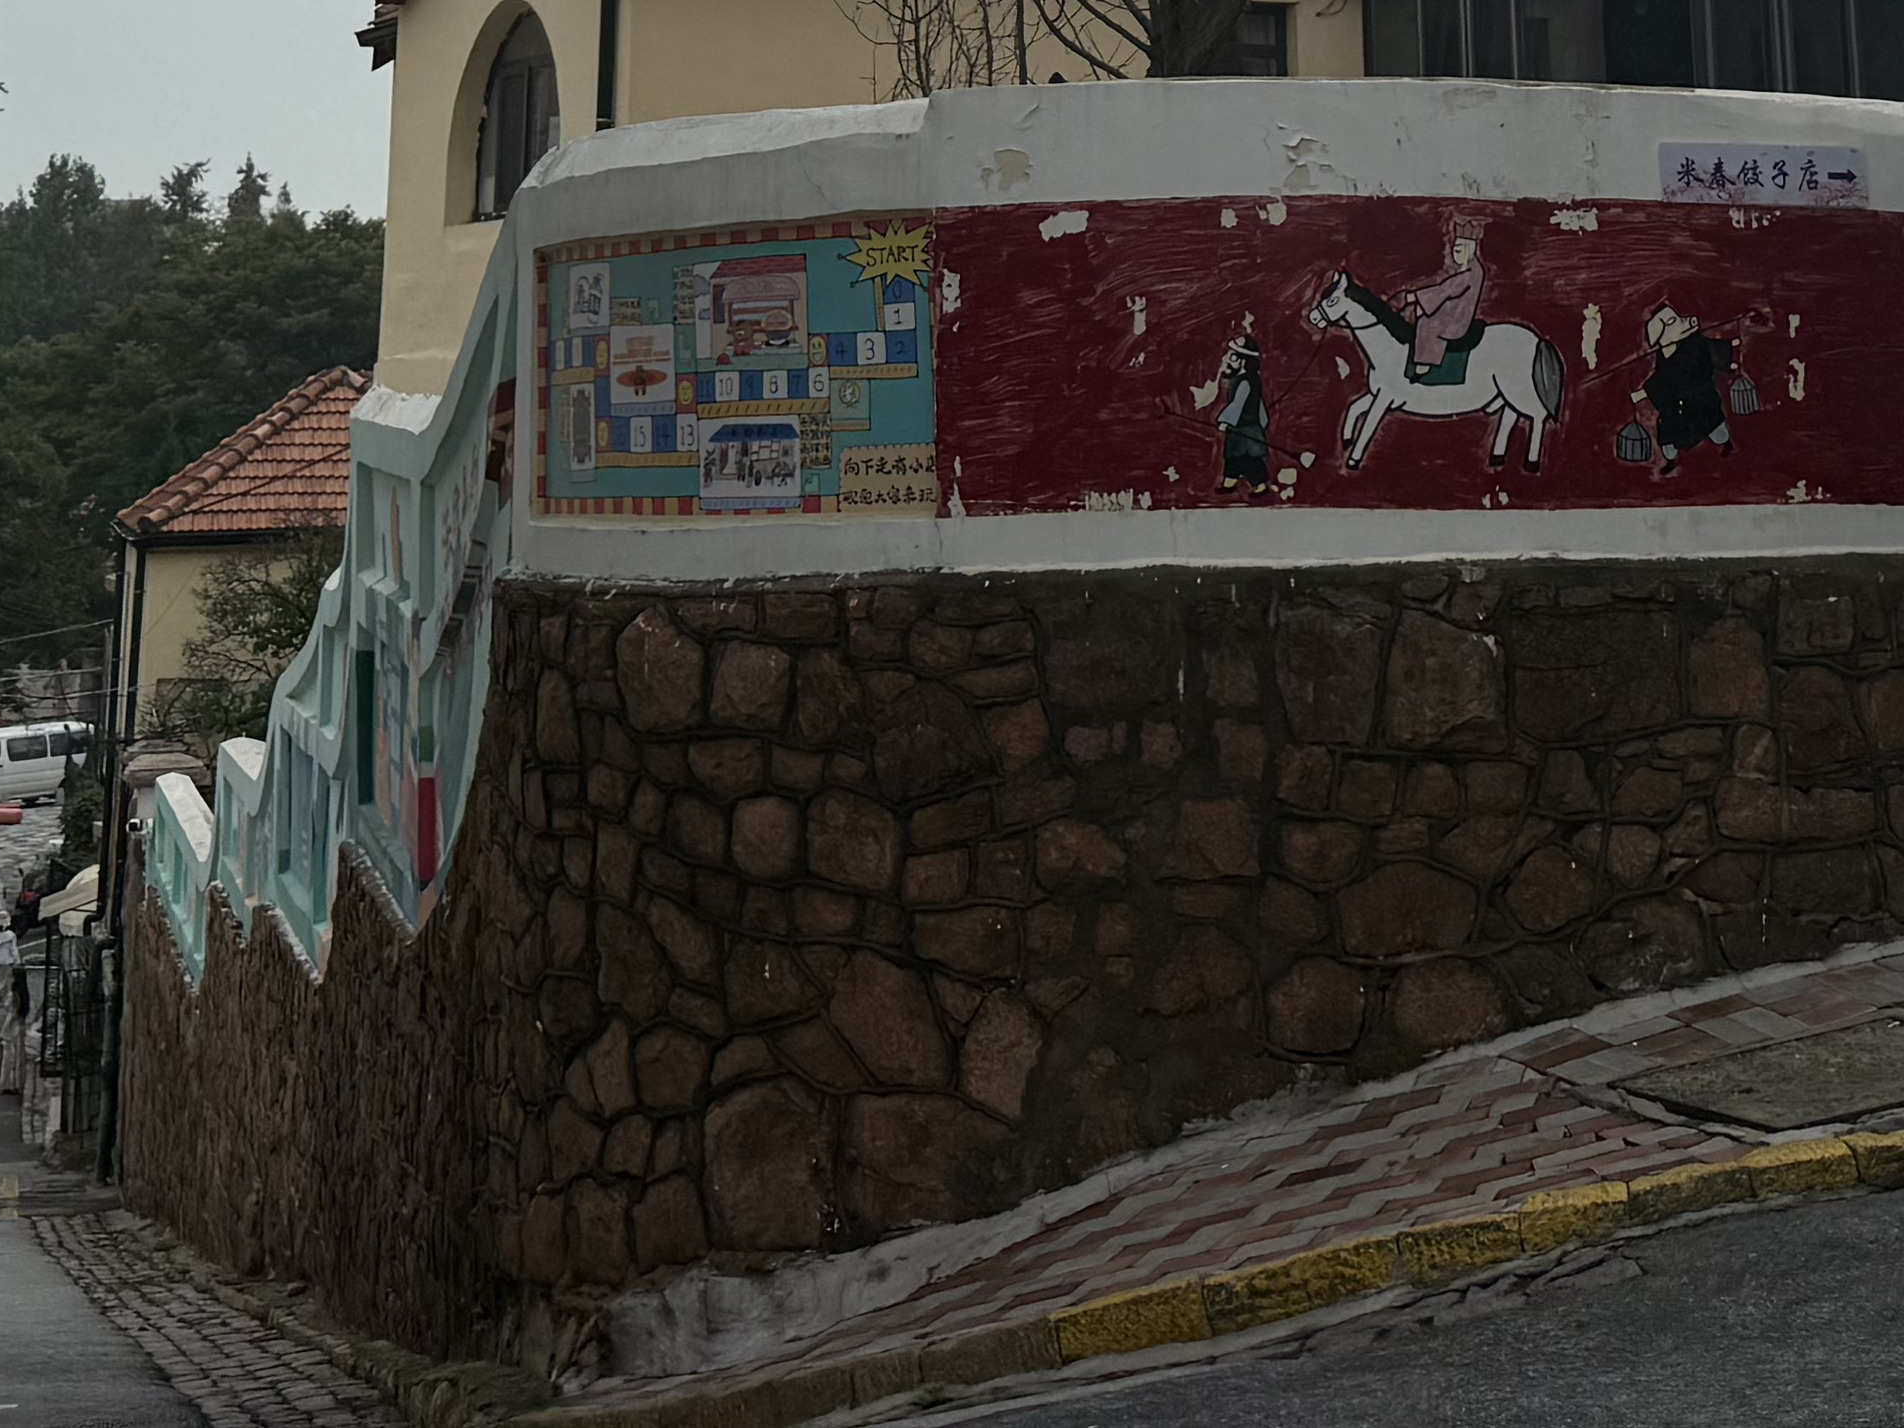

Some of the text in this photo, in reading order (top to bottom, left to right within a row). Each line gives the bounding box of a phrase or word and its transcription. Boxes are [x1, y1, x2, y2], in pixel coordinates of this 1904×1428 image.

[1676, 156, 1820, 192] 米春饺子店
[866, 245, 918, 267] START
[893, 308, 903, 325] 1
[864, 337, 875, 360] 3
[718, 377, 734, 396] 10
[769, 375, 778, 394] 8
[814, 373, 824, 392] 6
[634, 424, 646, 448] 15
[679, 423, 695, 447] 13
